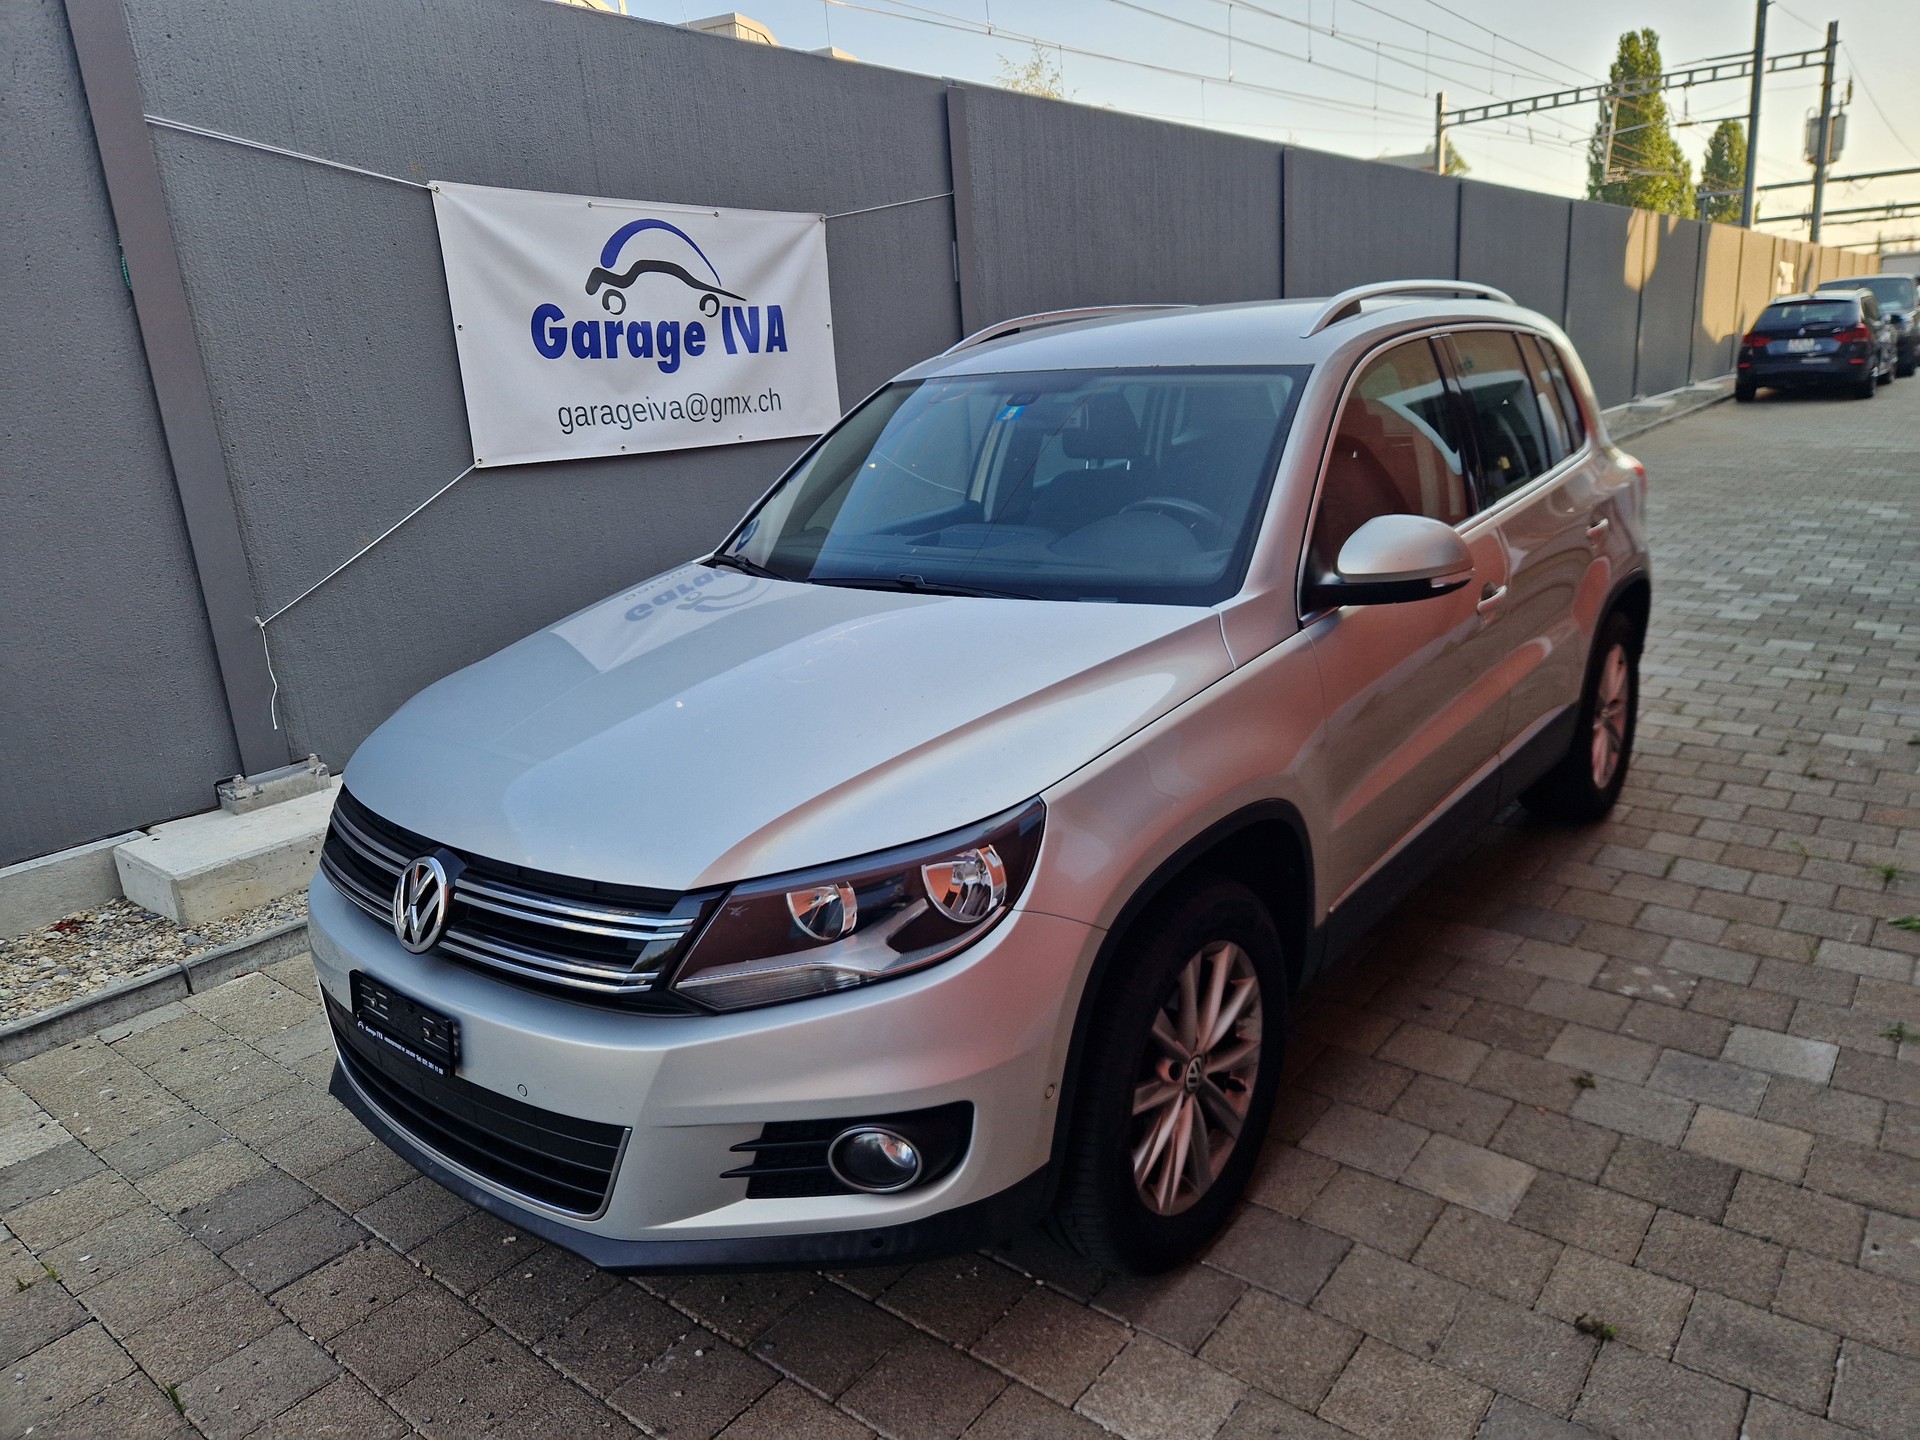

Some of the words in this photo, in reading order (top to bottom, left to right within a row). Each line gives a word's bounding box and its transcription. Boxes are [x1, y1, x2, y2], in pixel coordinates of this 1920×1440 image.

[531, 303, 706, 374] Garage
[721, 304, 788, 355] IVA
[557, 388, 782, 435] garageiva@gmx.ch
